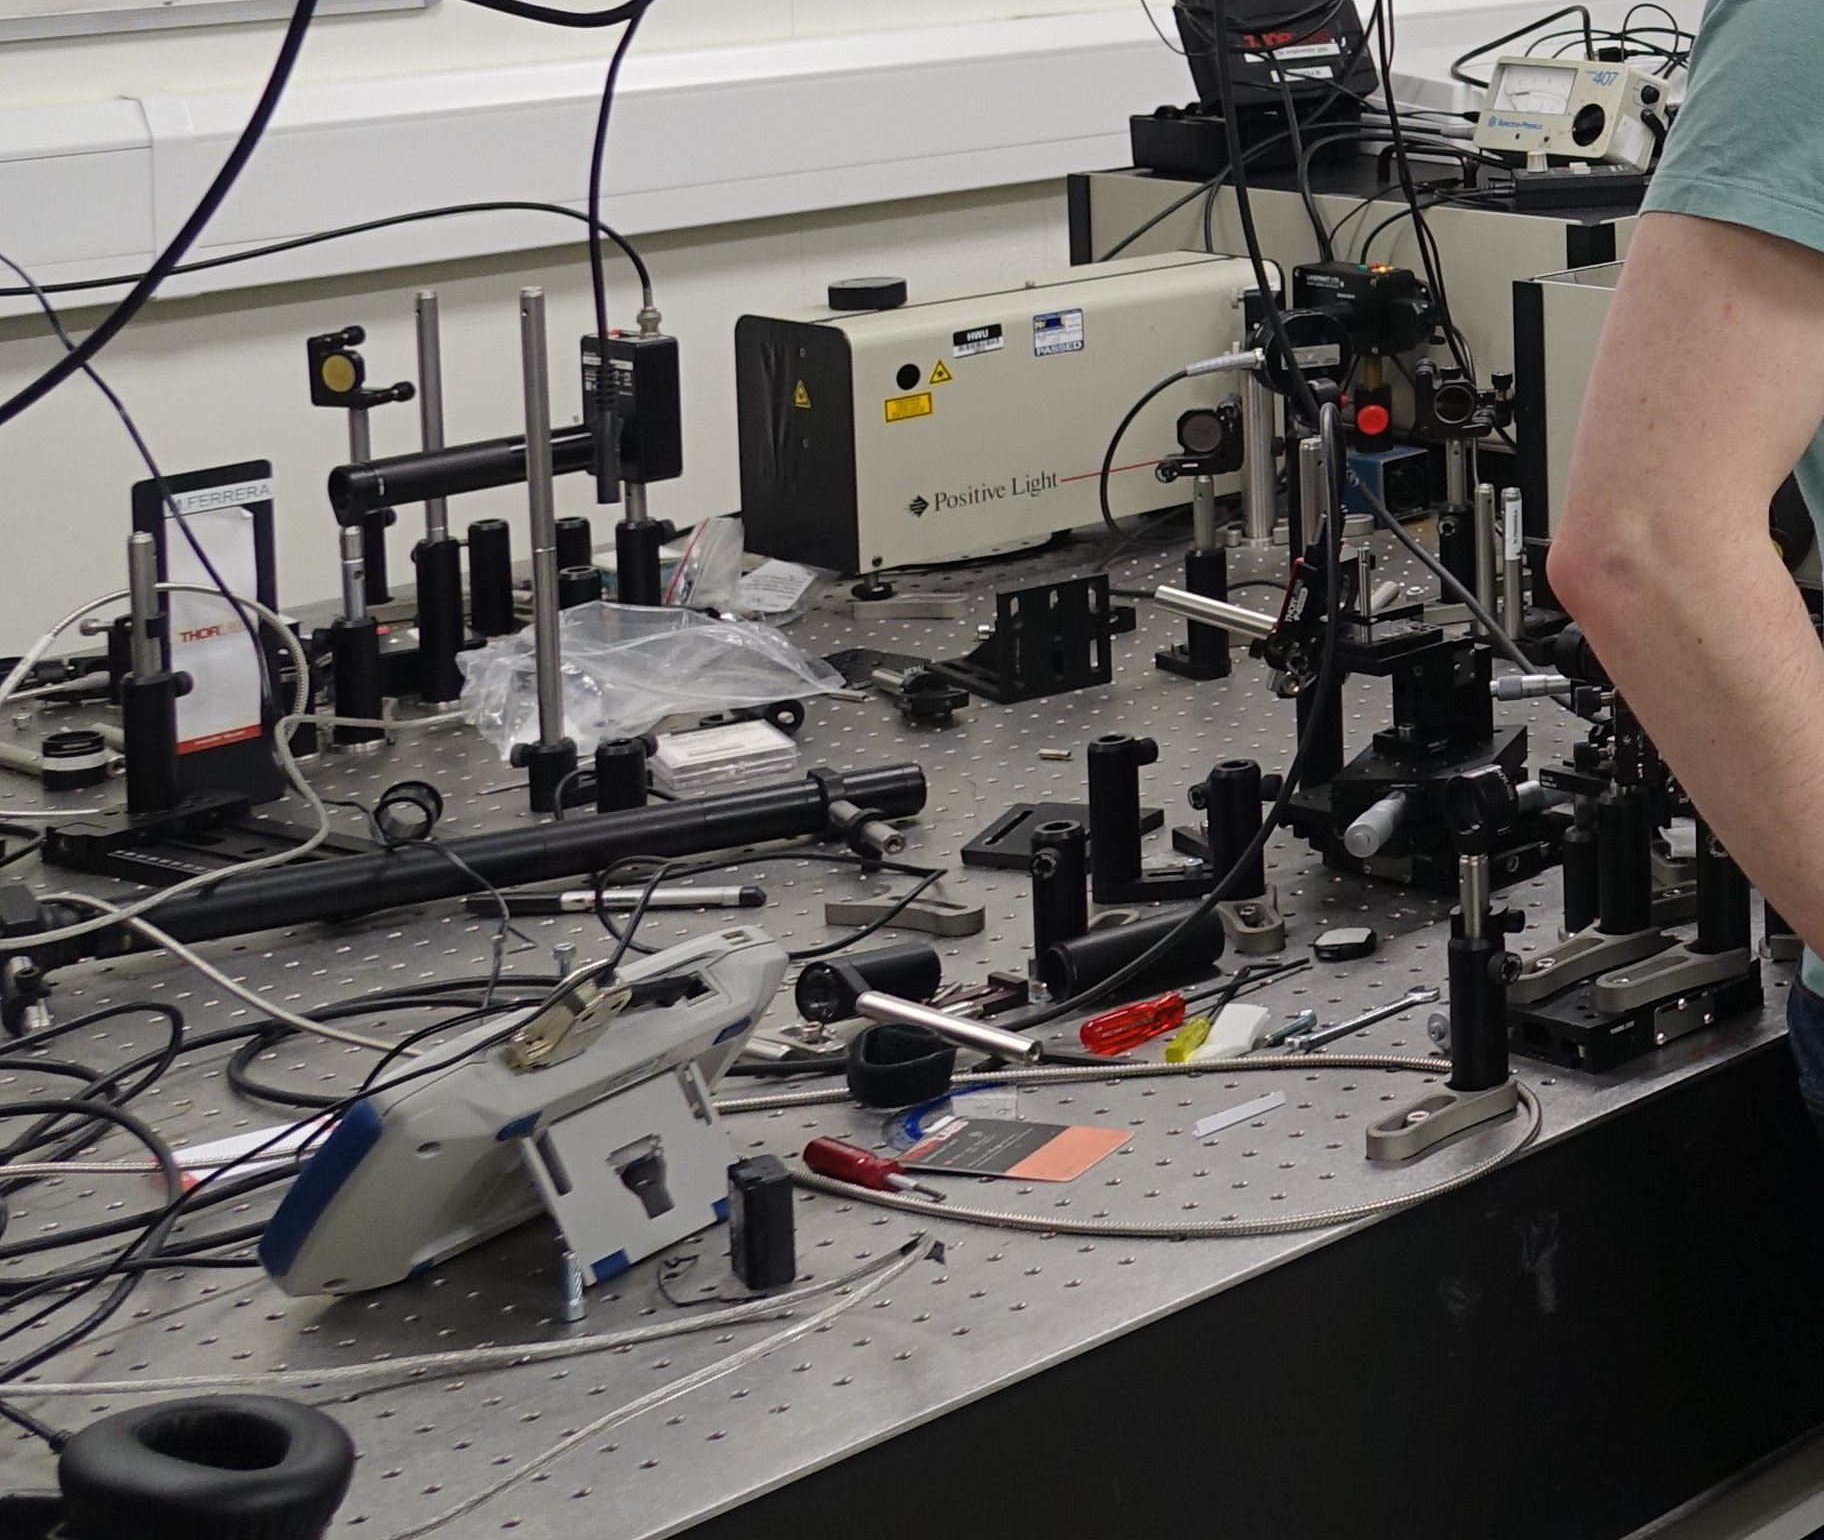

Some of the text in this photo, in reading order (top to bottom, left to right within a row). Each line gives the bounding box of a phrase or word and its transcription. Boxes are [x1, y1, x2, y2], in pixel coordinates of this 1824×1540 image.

[1592, 71, 1619, 86] 407
[966, 328, 989, 341] HWU
[1035, 340, 1083, 357] PASSED
[933, 471, 1058, 512] Positive Light
